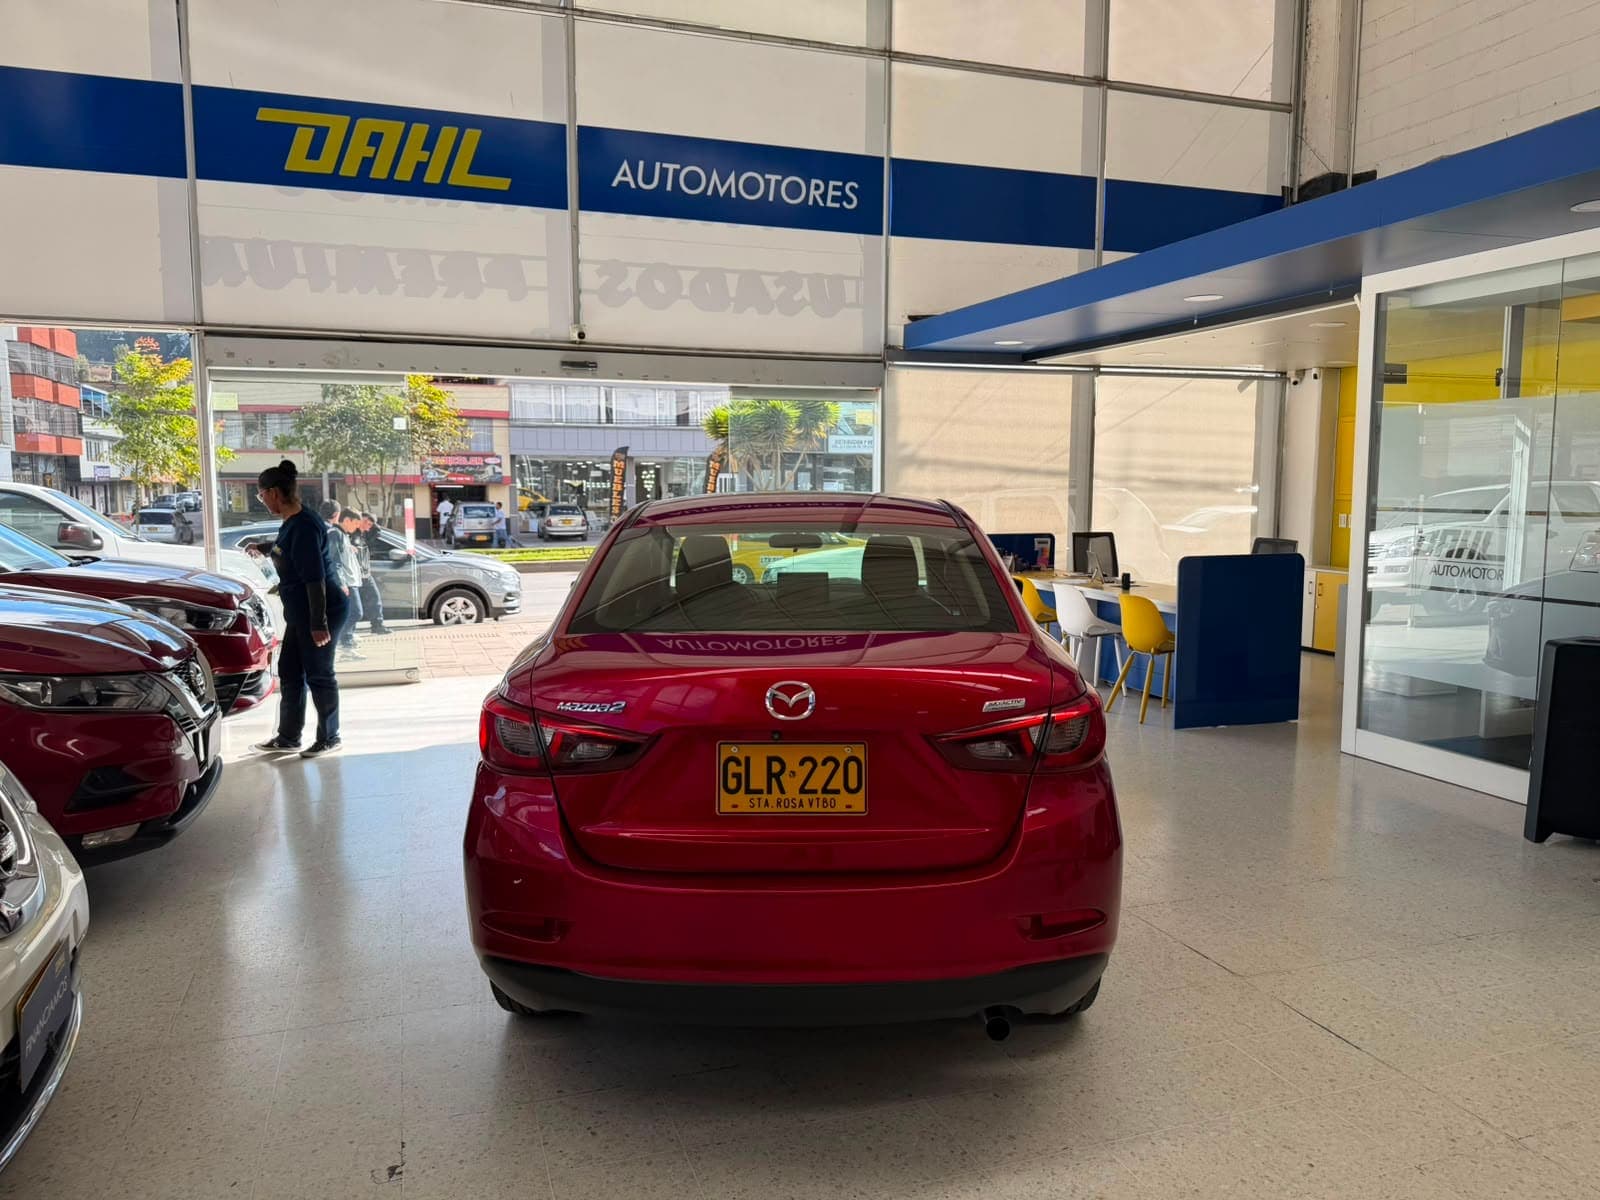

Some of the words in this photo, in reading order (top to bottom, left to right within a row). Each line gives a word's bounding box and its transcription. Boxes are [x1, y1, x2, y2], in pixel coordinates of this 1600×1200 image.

[255, 106, 512, 192] DAHL
[610, 158, 859, 211] AUTOMOTORES
[1430, 564, 1504, 581] AUTOMOTOR
[722, 755, 786, 795] GLR
[798, 756, 863, 795] 220
